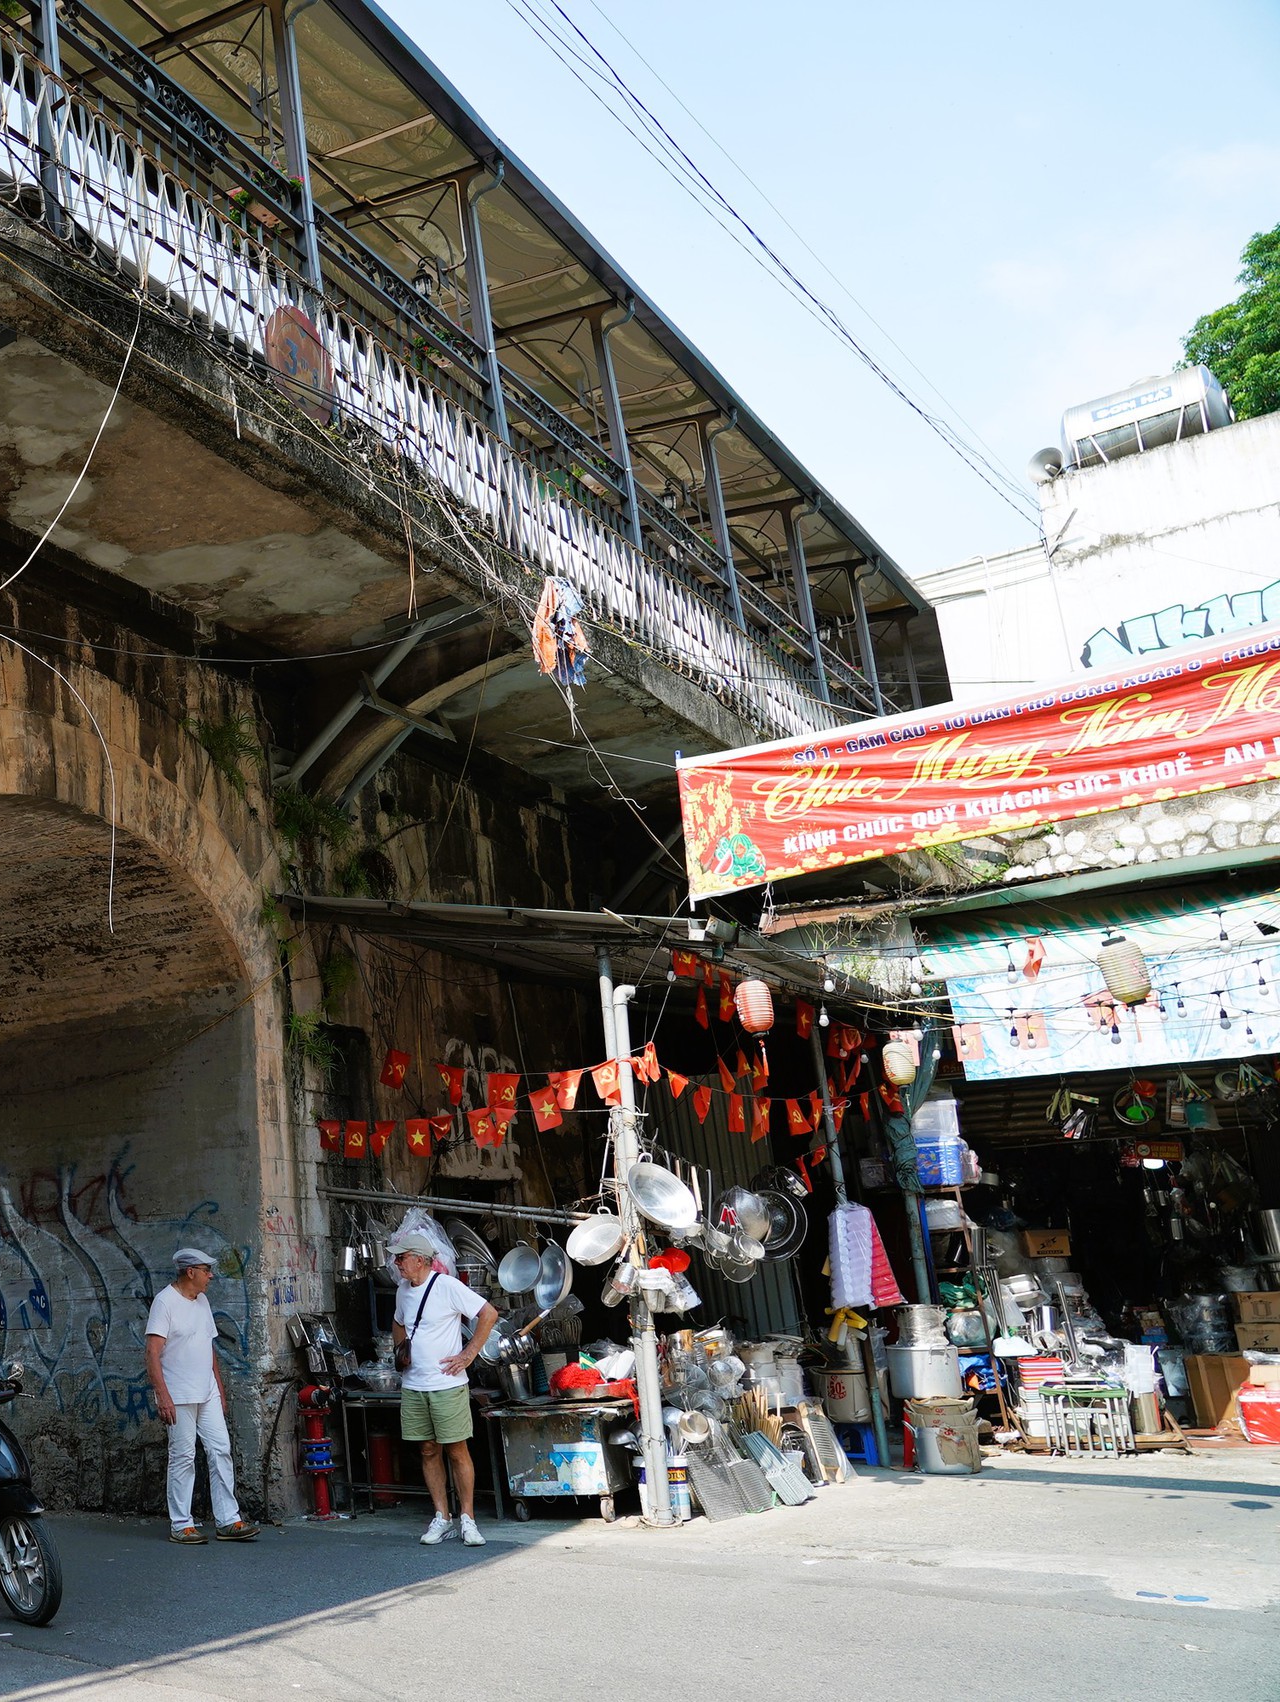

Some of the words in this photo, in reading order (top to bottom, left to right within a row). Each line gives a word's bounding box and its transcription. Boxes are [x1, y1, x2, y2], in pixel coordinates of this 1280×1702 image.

[752, 762, 885, 823] Chúc
[873, 732, 1050, 802] Mừng
[1051, 692, 1190, 758] Năm
[782, 829, 836, 855] KÍNH
[843, 815, 904, 842] CHÚC
[911, 803, 957, 829] QUÝ
[964, 786, 1050, 818] KHÁCH
[1057, 769, 1112, 799] SỨC
[1119, 750, 1194, 788] KHOẺ
[1223, 741, 1266, 767] AN
[820, 747, 830, 760] 1
